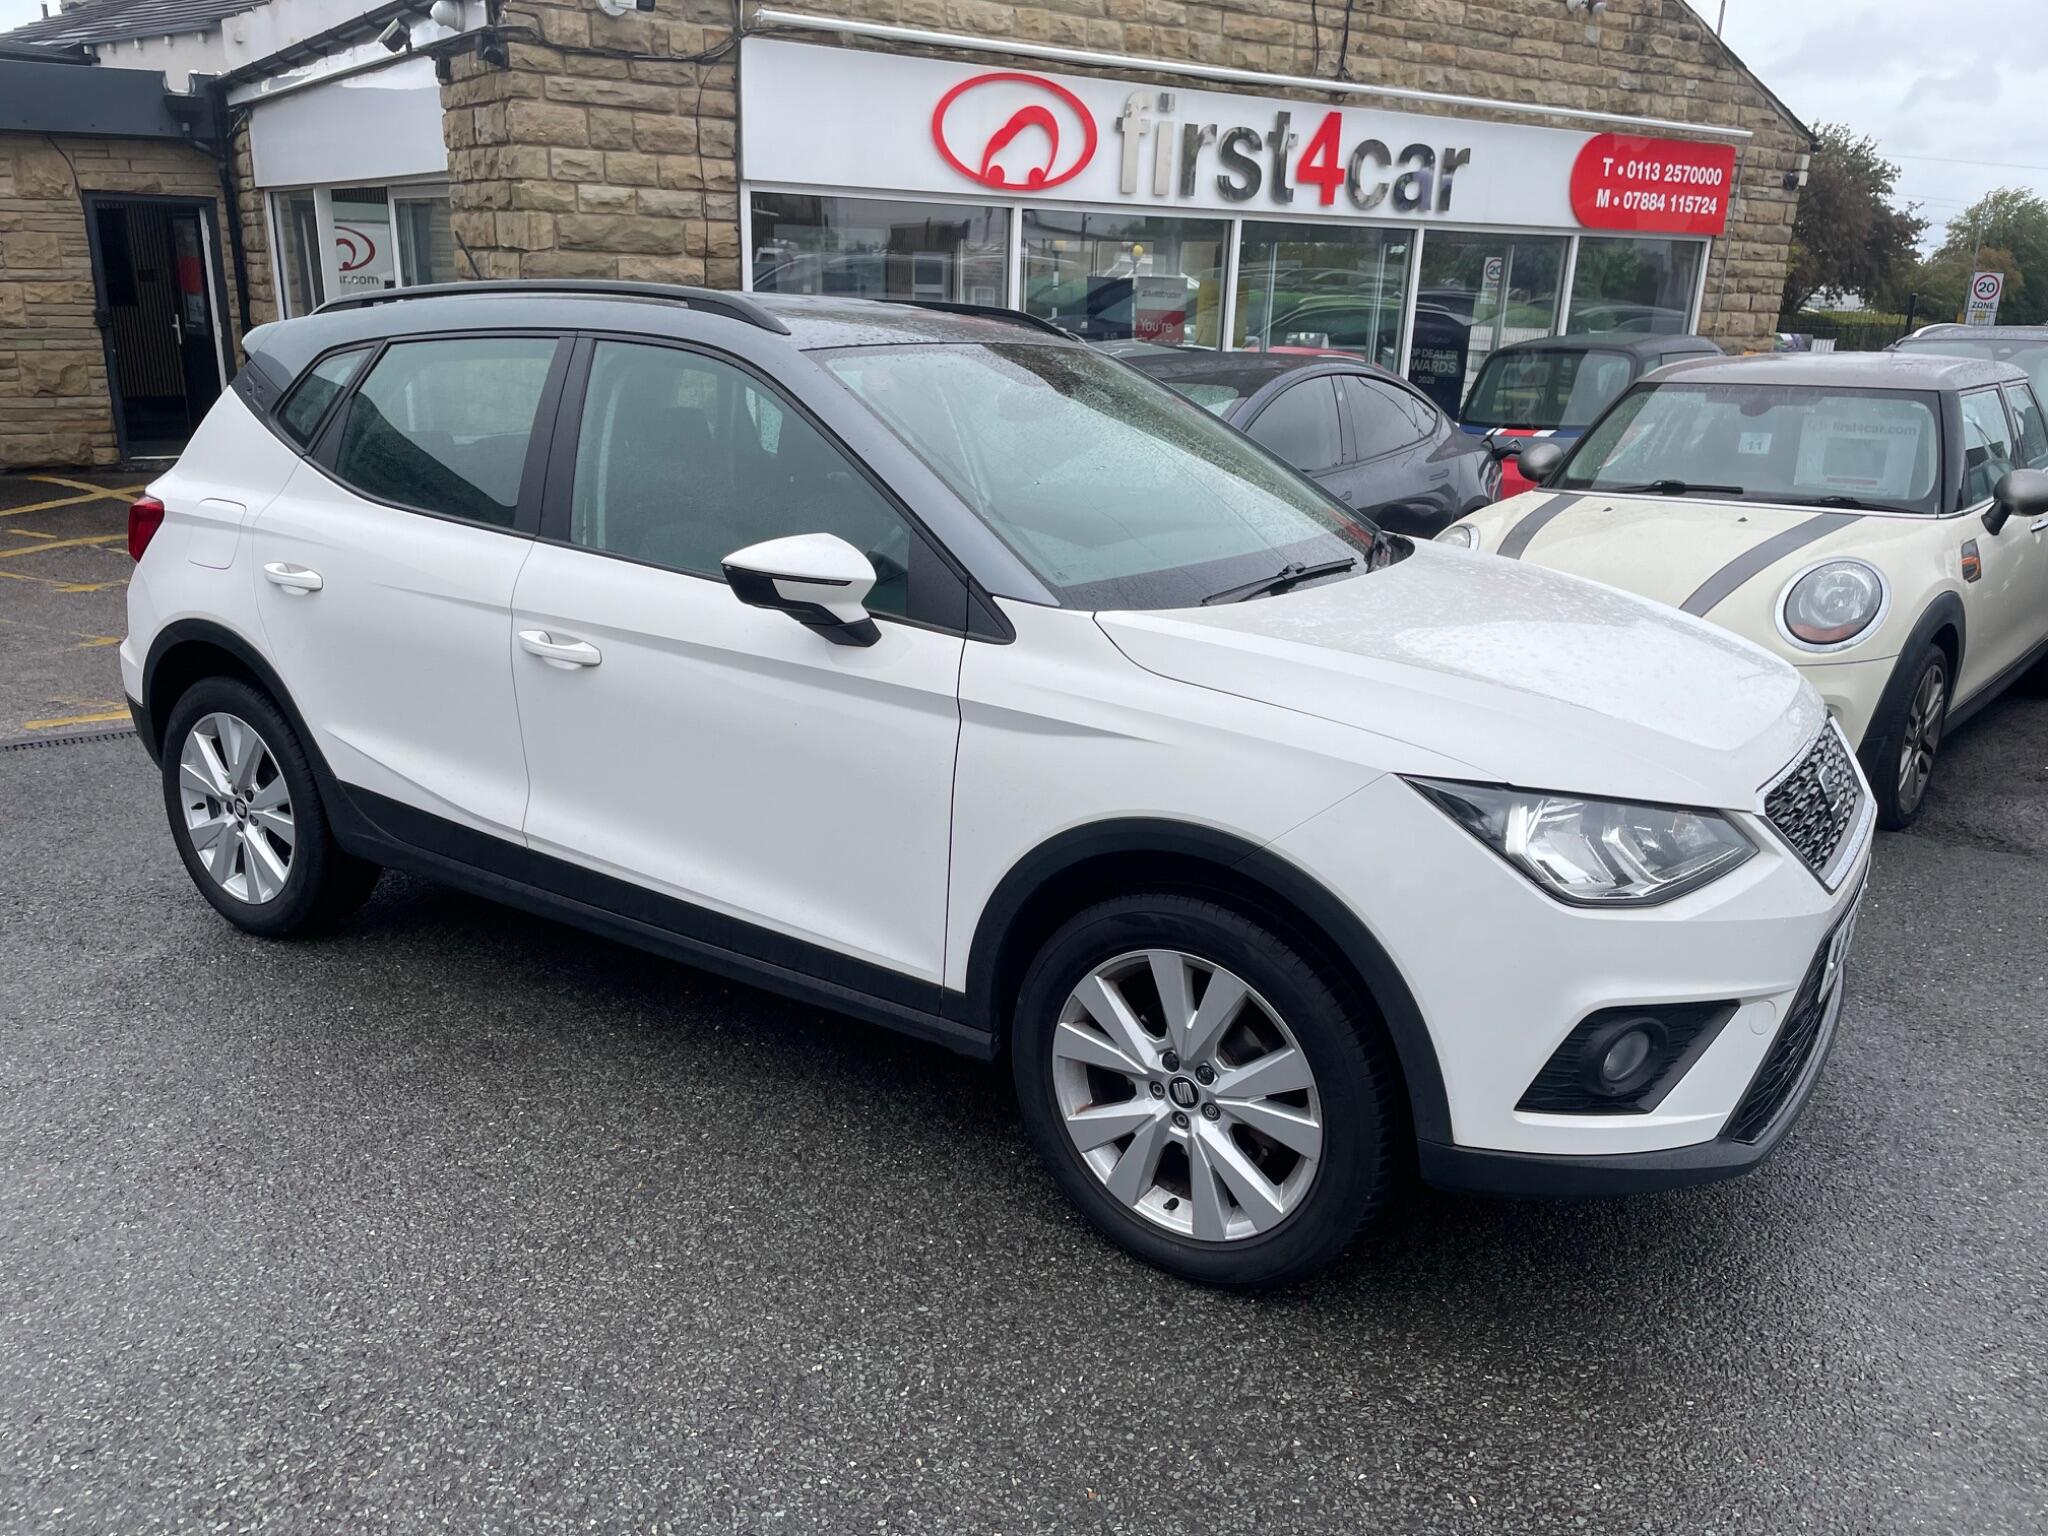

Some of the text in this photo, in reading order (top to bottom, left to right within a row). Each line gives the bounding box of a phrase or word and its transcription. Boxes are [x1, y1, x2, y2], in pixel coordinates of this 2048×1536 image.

[1116, 91, 1471, 212] first4car
[1603, 157, 1722, 186] T 0113 2570000
[1596, 188, 1717, 215] M 07884 115724
[1978, 282, 1995, 293] 20
[1972, 301, 1994, 309] ZONE
[1140, 319, 1174, 333] You're
[1422, 348, 1458, 360] DEALER
[1411, 358, 1457, 374] WARDS
